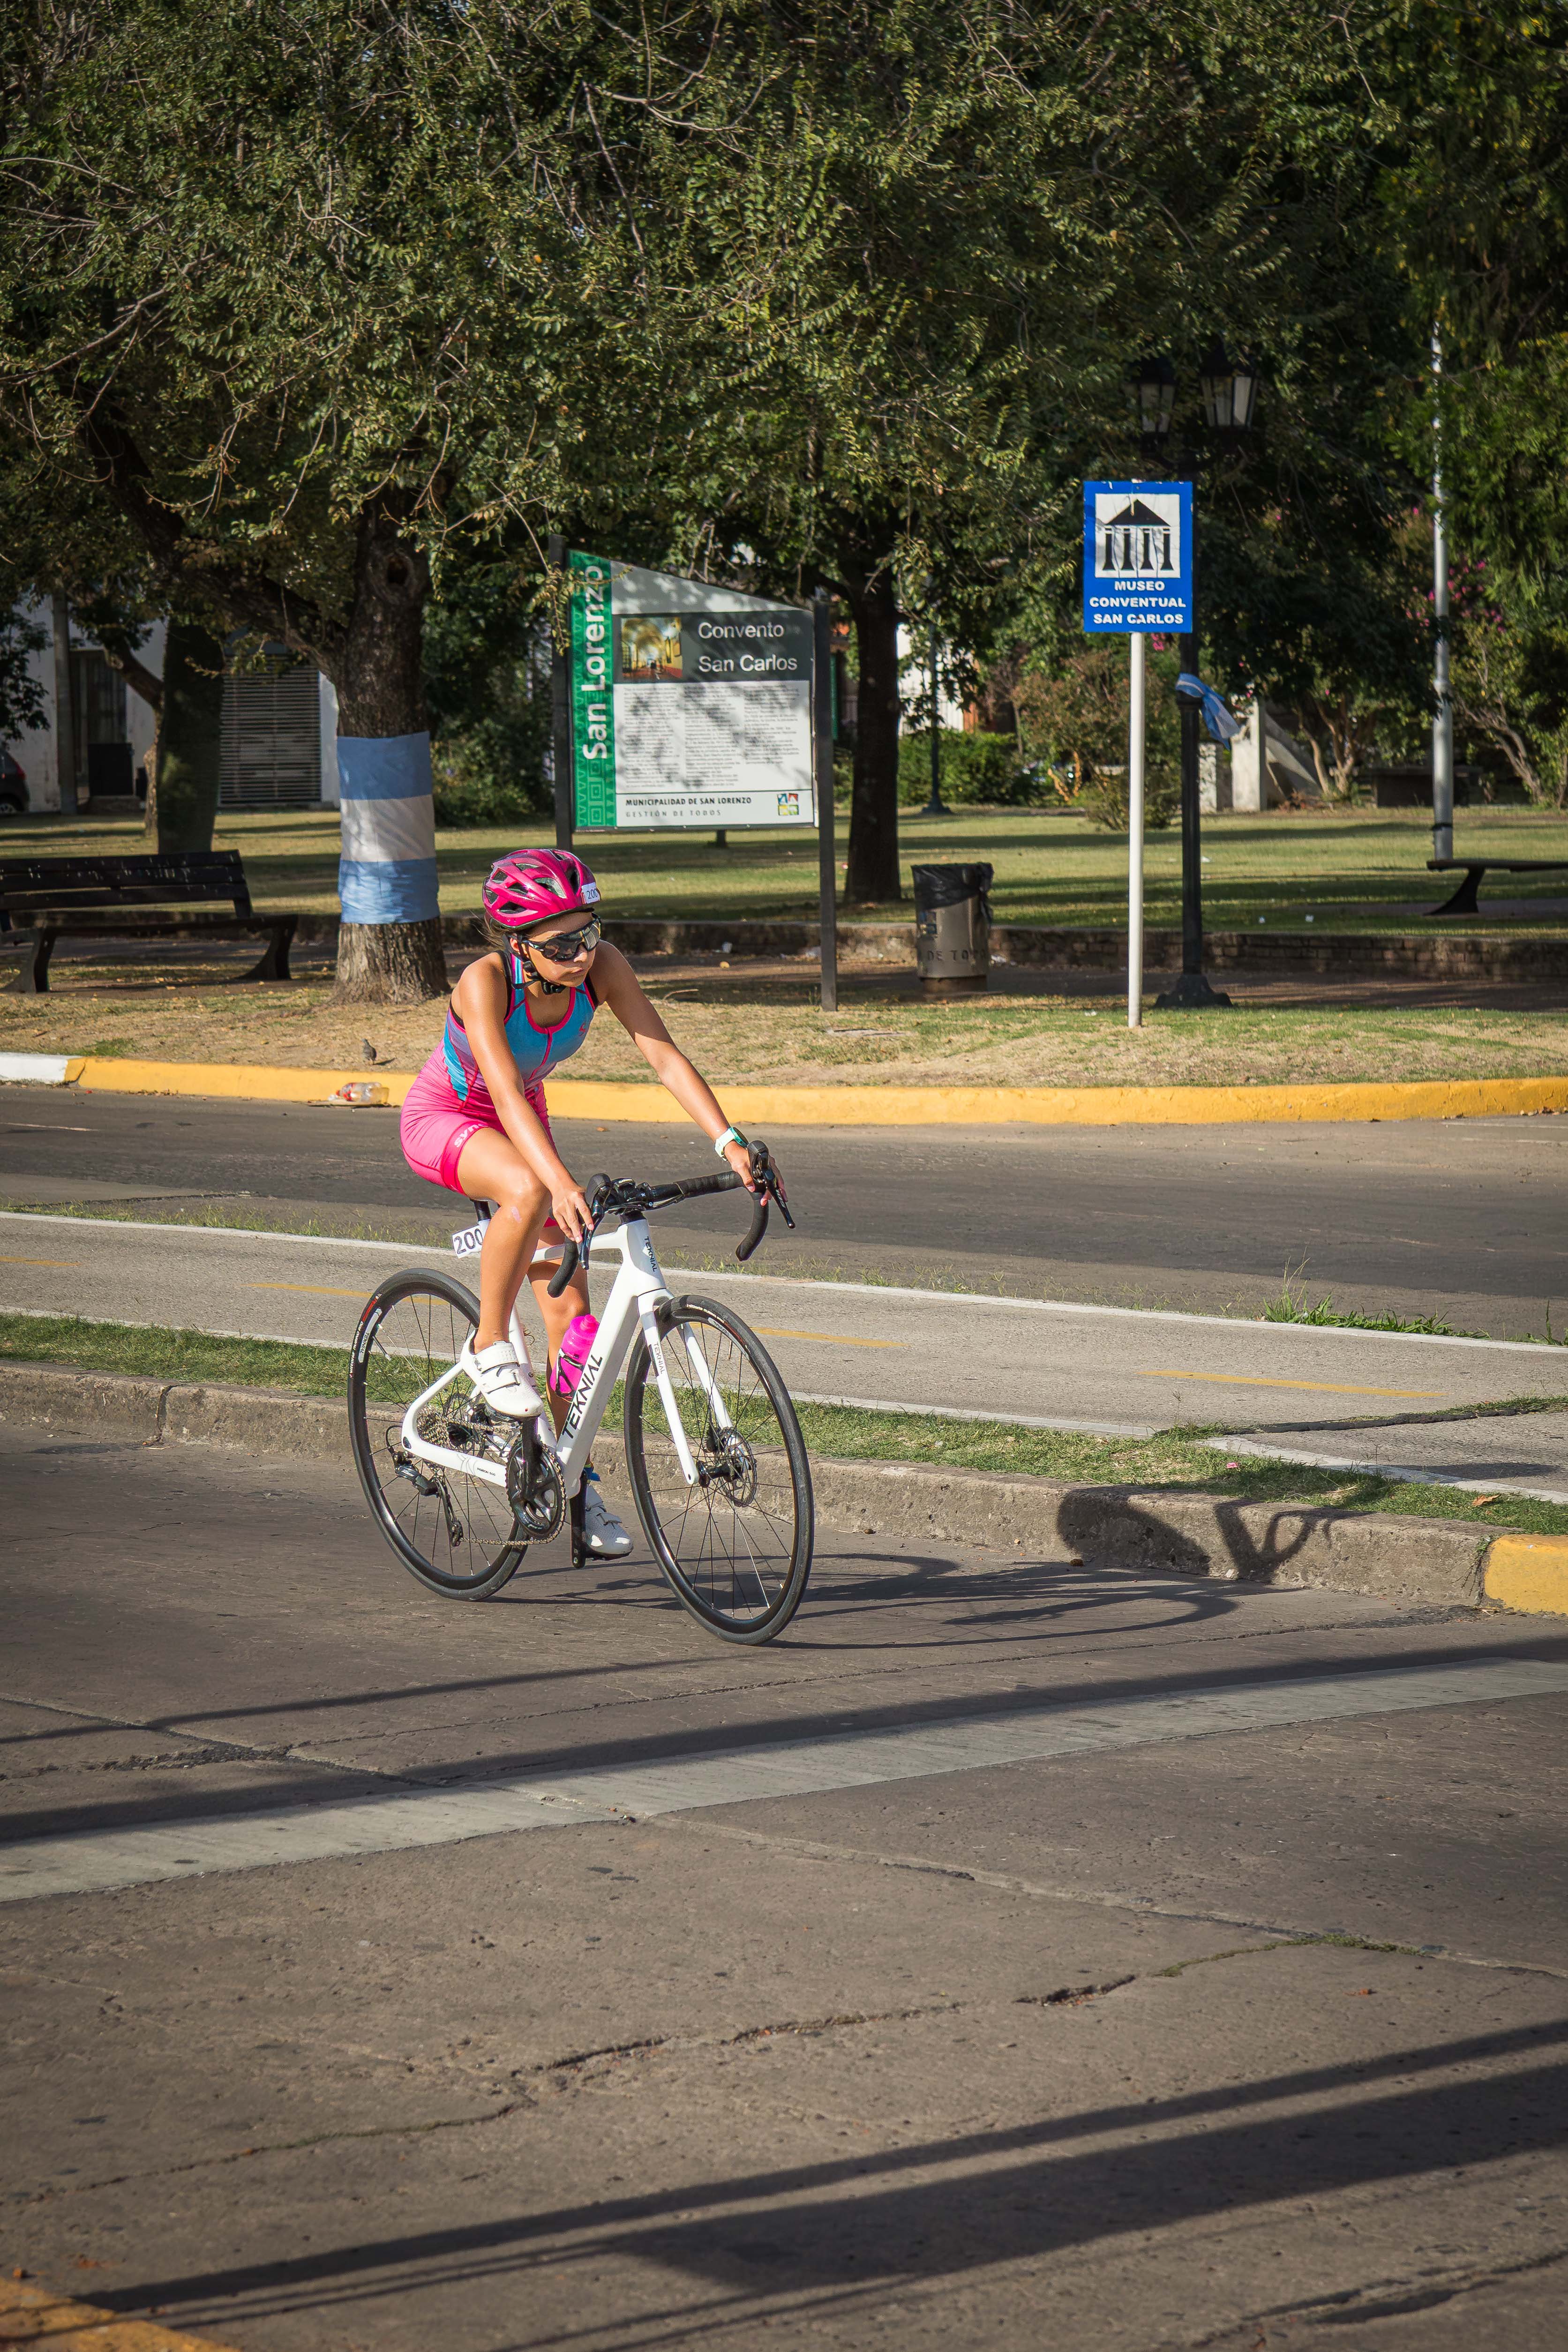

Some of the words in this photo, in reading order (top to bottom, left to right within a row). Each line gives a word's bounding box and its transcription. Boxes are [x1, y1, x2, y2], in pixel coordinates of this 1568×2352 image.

[1114, 581, 1165, 591] MUSEO
[1089, 597, 1186, 607] CONVENTUAL
[581, 565, 606, 691] Lorenzo
[698, 622, 785, 639] Convento
[1093, 614, 1123, 624] SAN
[1126, 614, 1184, 624] CARLOS
[698, 655, 735, 672] San
[739, 654, 798, 672] Carlos
[583, 703, 608, 760] San
[644, 1236, 658, 1272] TEKNIAL
[653, 1341, 666, 1374] TEKNIAL
[562, 1354, 603, 1439] TEKNIAL
